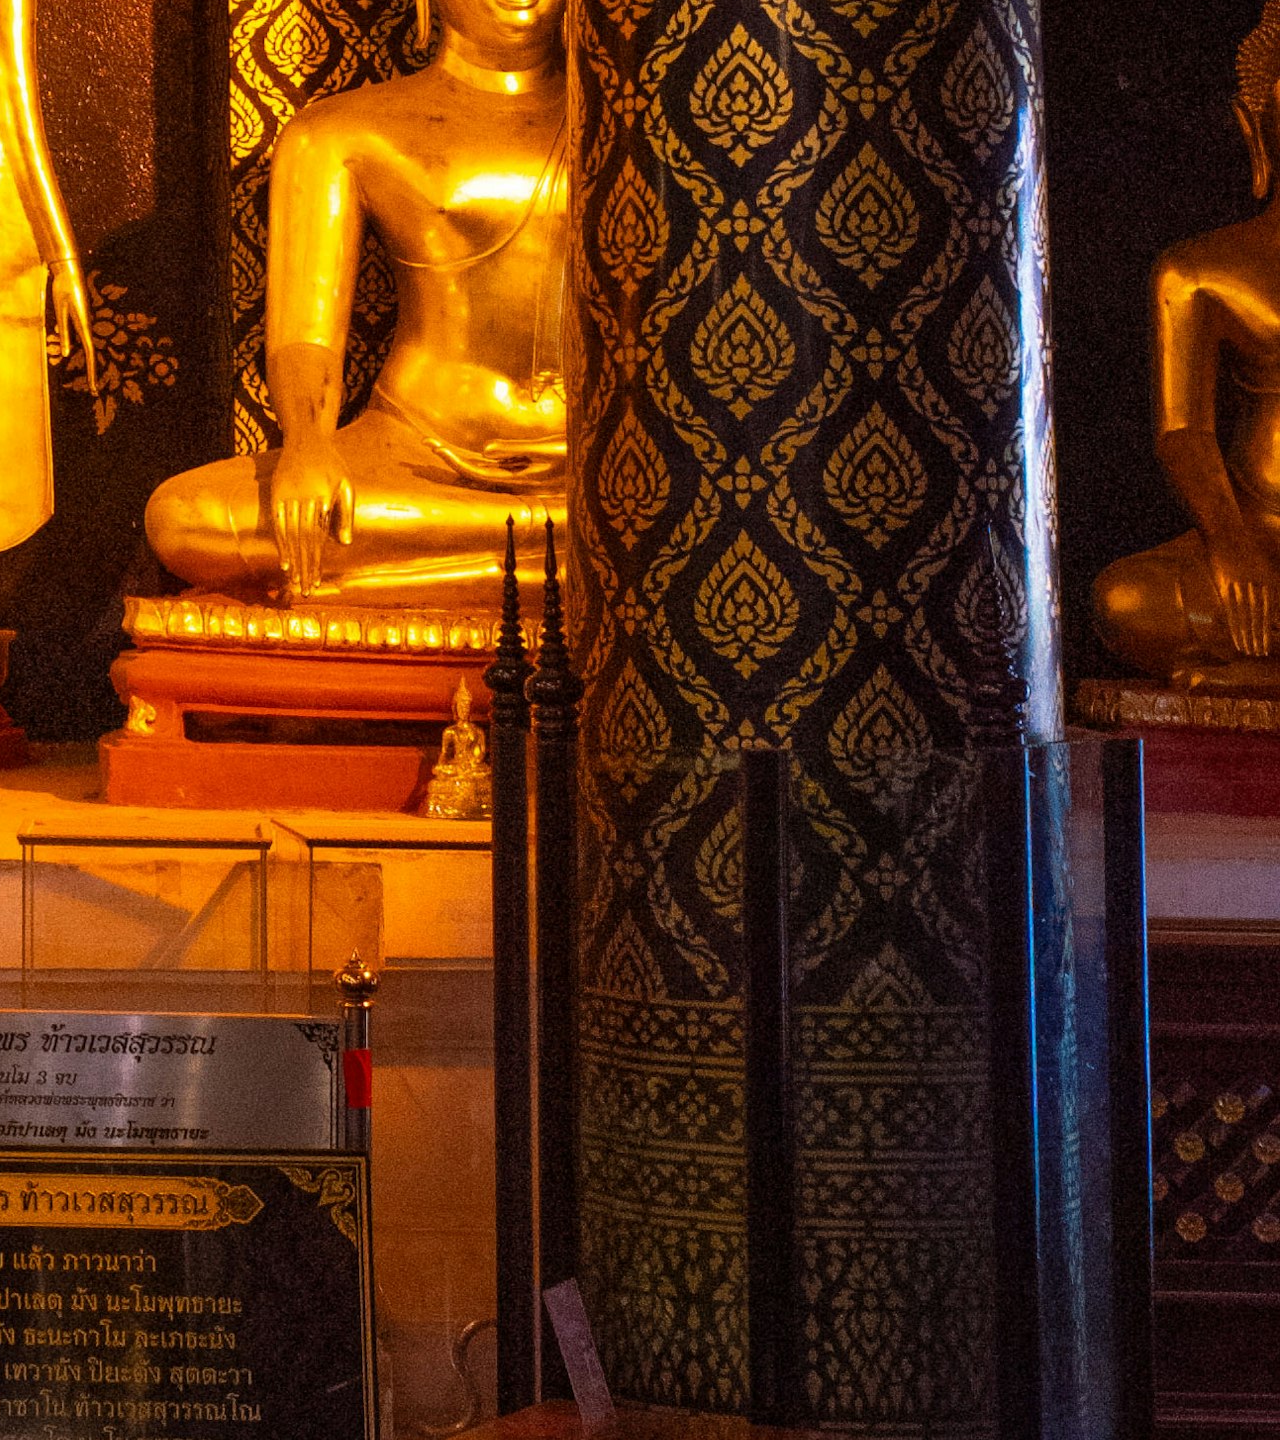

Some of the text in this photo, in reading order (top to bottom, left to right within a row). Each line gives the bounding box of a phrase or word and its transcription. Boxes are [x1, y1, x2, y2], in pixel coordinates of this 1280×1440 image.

[41, 1023, 217, 1064] ท้าวเวสสุวรรณ
[36, 1070, 47, 1085] 3
[55, 1071, 79, 1086] จบ
[20, 1180, 209, 1226] ท้าวเวสสุวรรณ
[12, 1243, 56, 1271] แล้ว
[61, 1244, 157, 1273] ภาวนาว่า
[71, 1286, 98, 1312] มัง
[105, 1284, 243, 1321] นะโมพุทธายะ
[23, 1318, 127, 1349] ธะนะกาโม
[134, 1325, 236, 1350] ละเภธะนัง
[4, 1357, 82, 1383] เทวานัง
